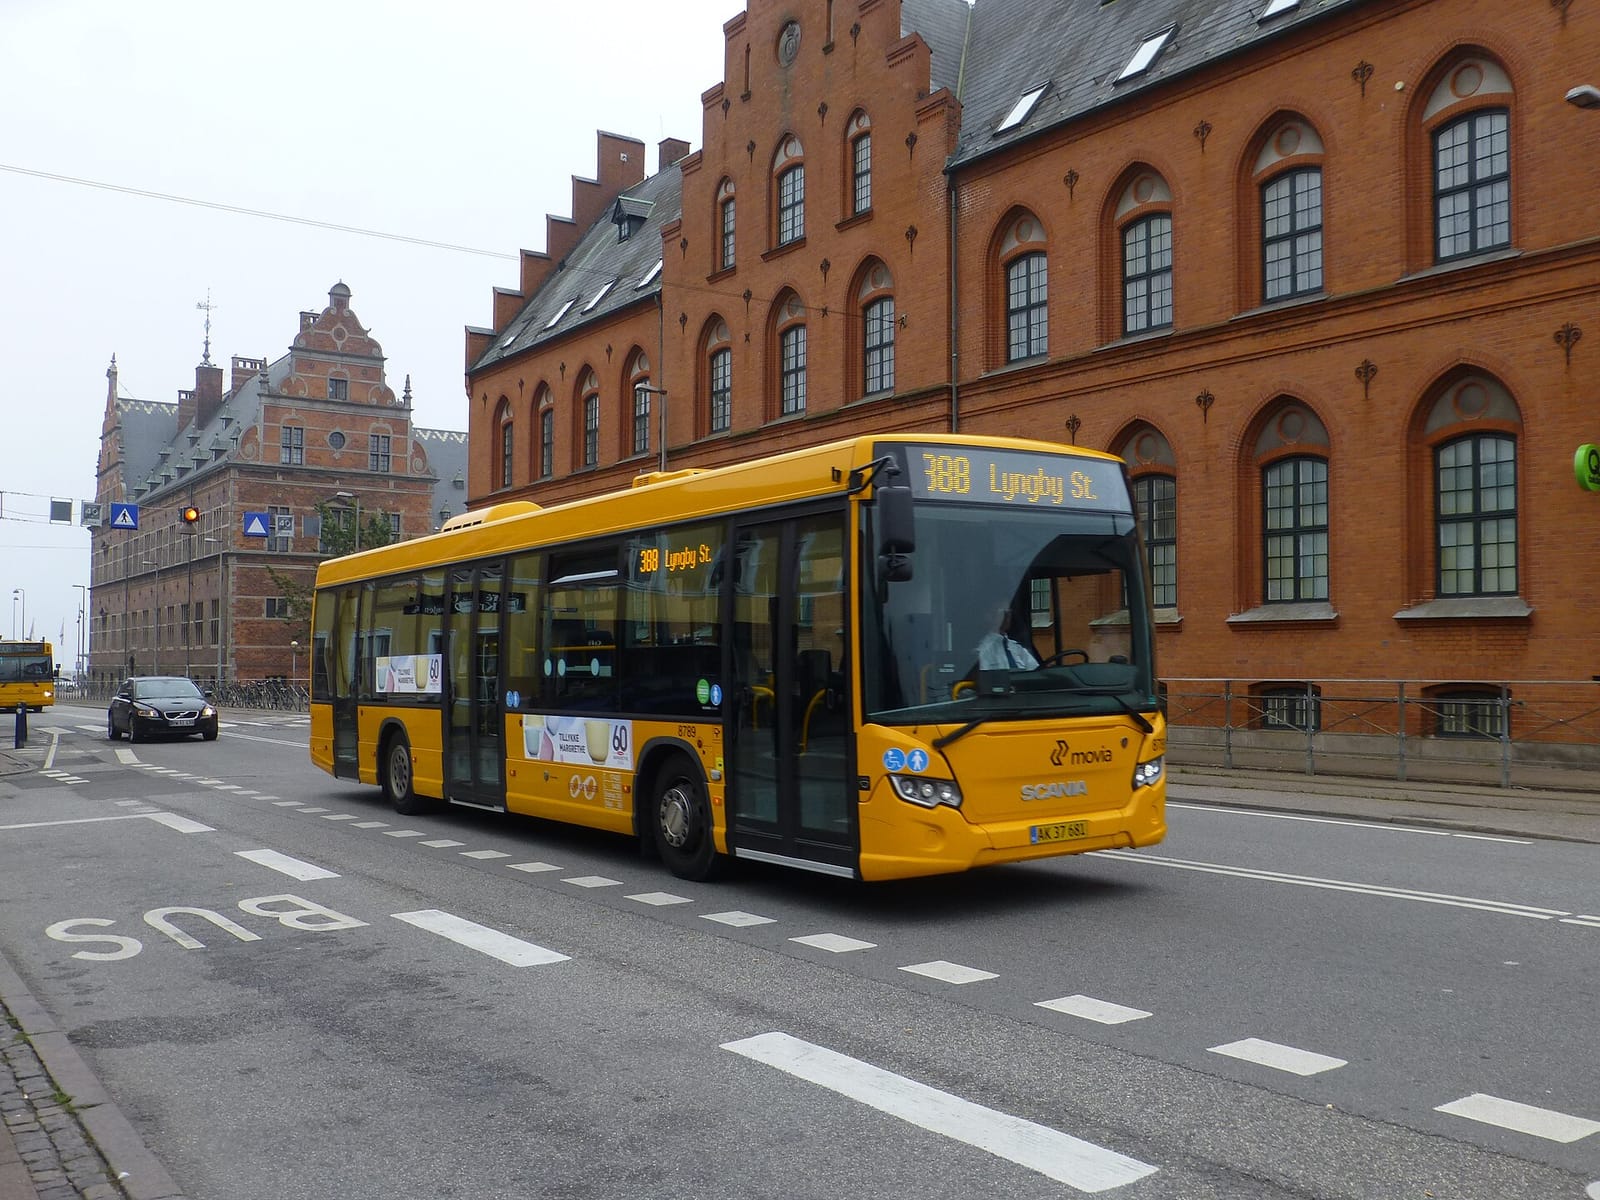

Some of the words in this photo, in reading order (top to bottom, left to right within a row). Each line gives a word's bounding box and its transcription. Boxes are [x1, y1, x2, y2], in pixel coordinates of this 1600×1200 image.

[922, 453, 971, 494] 388
[989, 463, 1064, 504] Lyngby
[1070, 471, 1098, 500] St.
[278, 519, 292, 529] 40
[640, 548, 659, 573] 388
[664, 546, 697, 572] Lyngby
[699, 544, 712, 563] St.
[429, 658, 439, 679] 60
[558, 732, 580, 743] TILLYKKE
[612, 725, 628, 752] 60
[677, 725, 697, 738] 8789
[559, 743, 586, 754] MARGRETHE
[1071, 745, 1113, 765] movia
[1020, 780, 1088, 801] SCANIA
[1037, 827, 1051, 841] AK
[1054, 825, 1066, 839] 37
[45, 893, 371, 961] BUS
